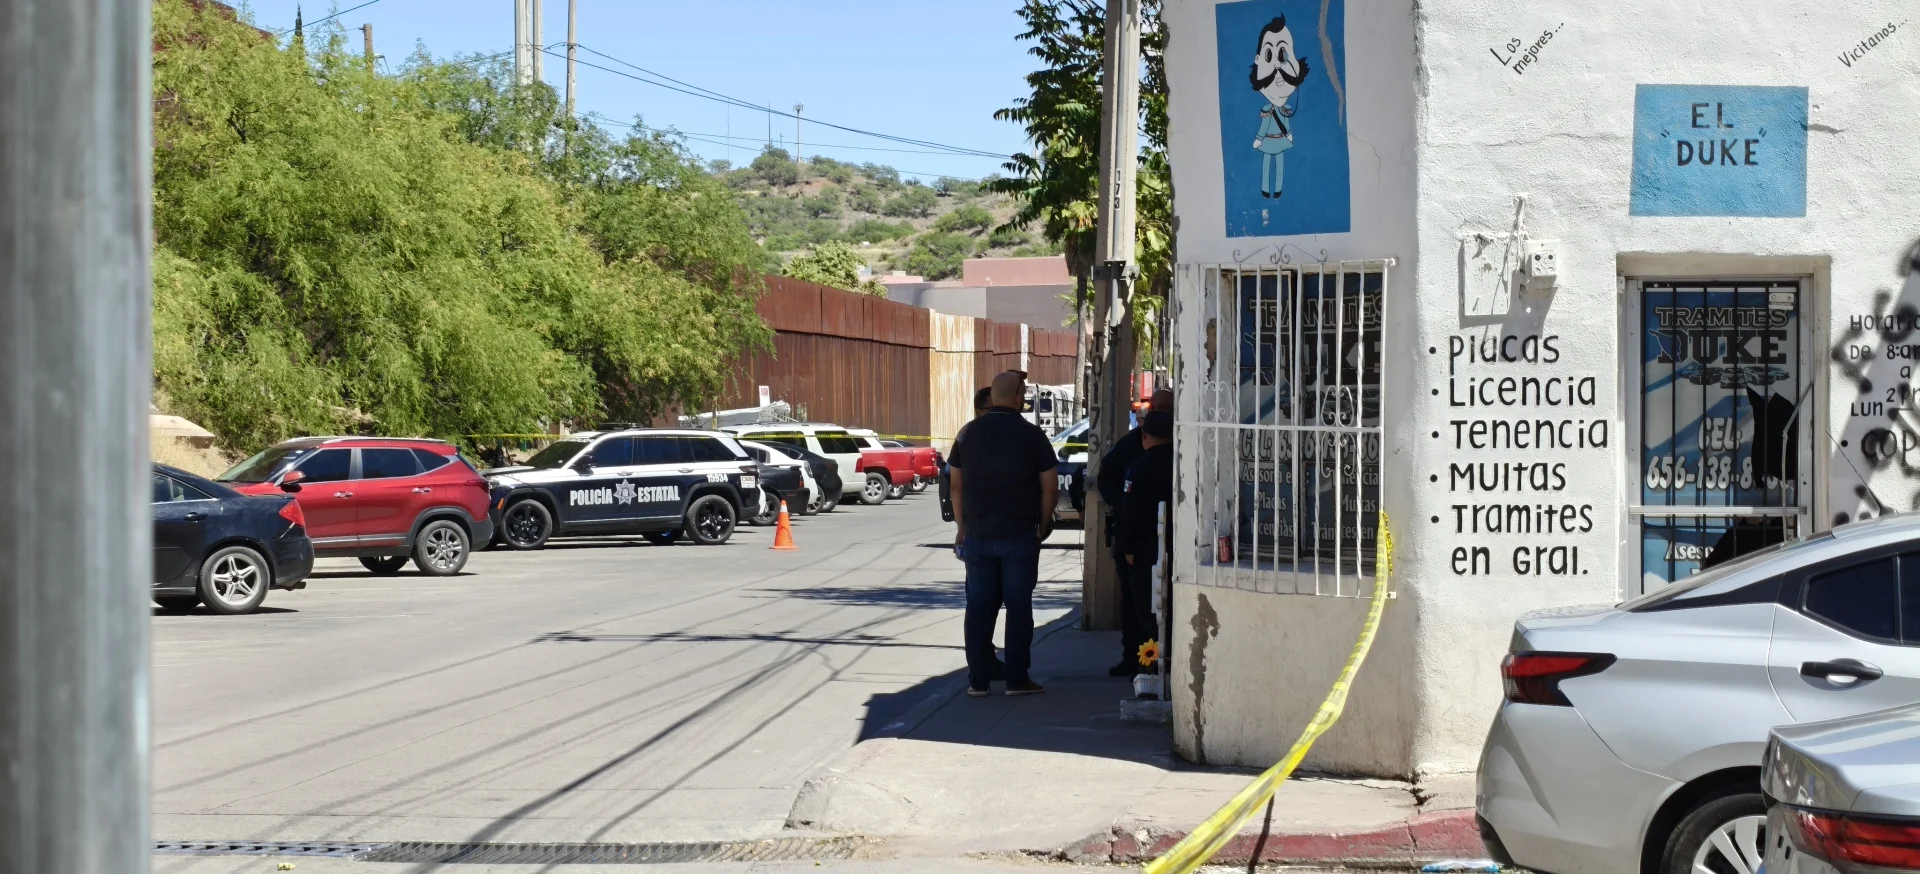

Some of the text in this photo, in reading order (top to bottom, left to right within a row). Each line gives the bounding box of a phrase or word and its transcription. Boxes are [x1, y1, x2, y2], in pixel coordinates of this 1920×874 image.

[1490, 37, 1521, 66] Los
[1691, 102, 1734, 129] EL
[1114, 169, 1122, 210] 173
[1654, 307, 1790, 327] TRAMITES
[1450, 334, 1560, 375] Placas
[1653, 329, 1788, 365] DUKE
[1900, 366, 1911, 379] a
[1450, 376, 1596, 407] Licencia
[1241, 430, 1272, 459] CL:
[1450, 419, 1609, 449] Tenencia
[1450, 462, 1567, 492] Multas
[570, 485, 680, 506] POLICÍA ESTATAL
[1452, 504, 1594, 534] Tramites
[1451, 545, 1589, 576] en Gral.
